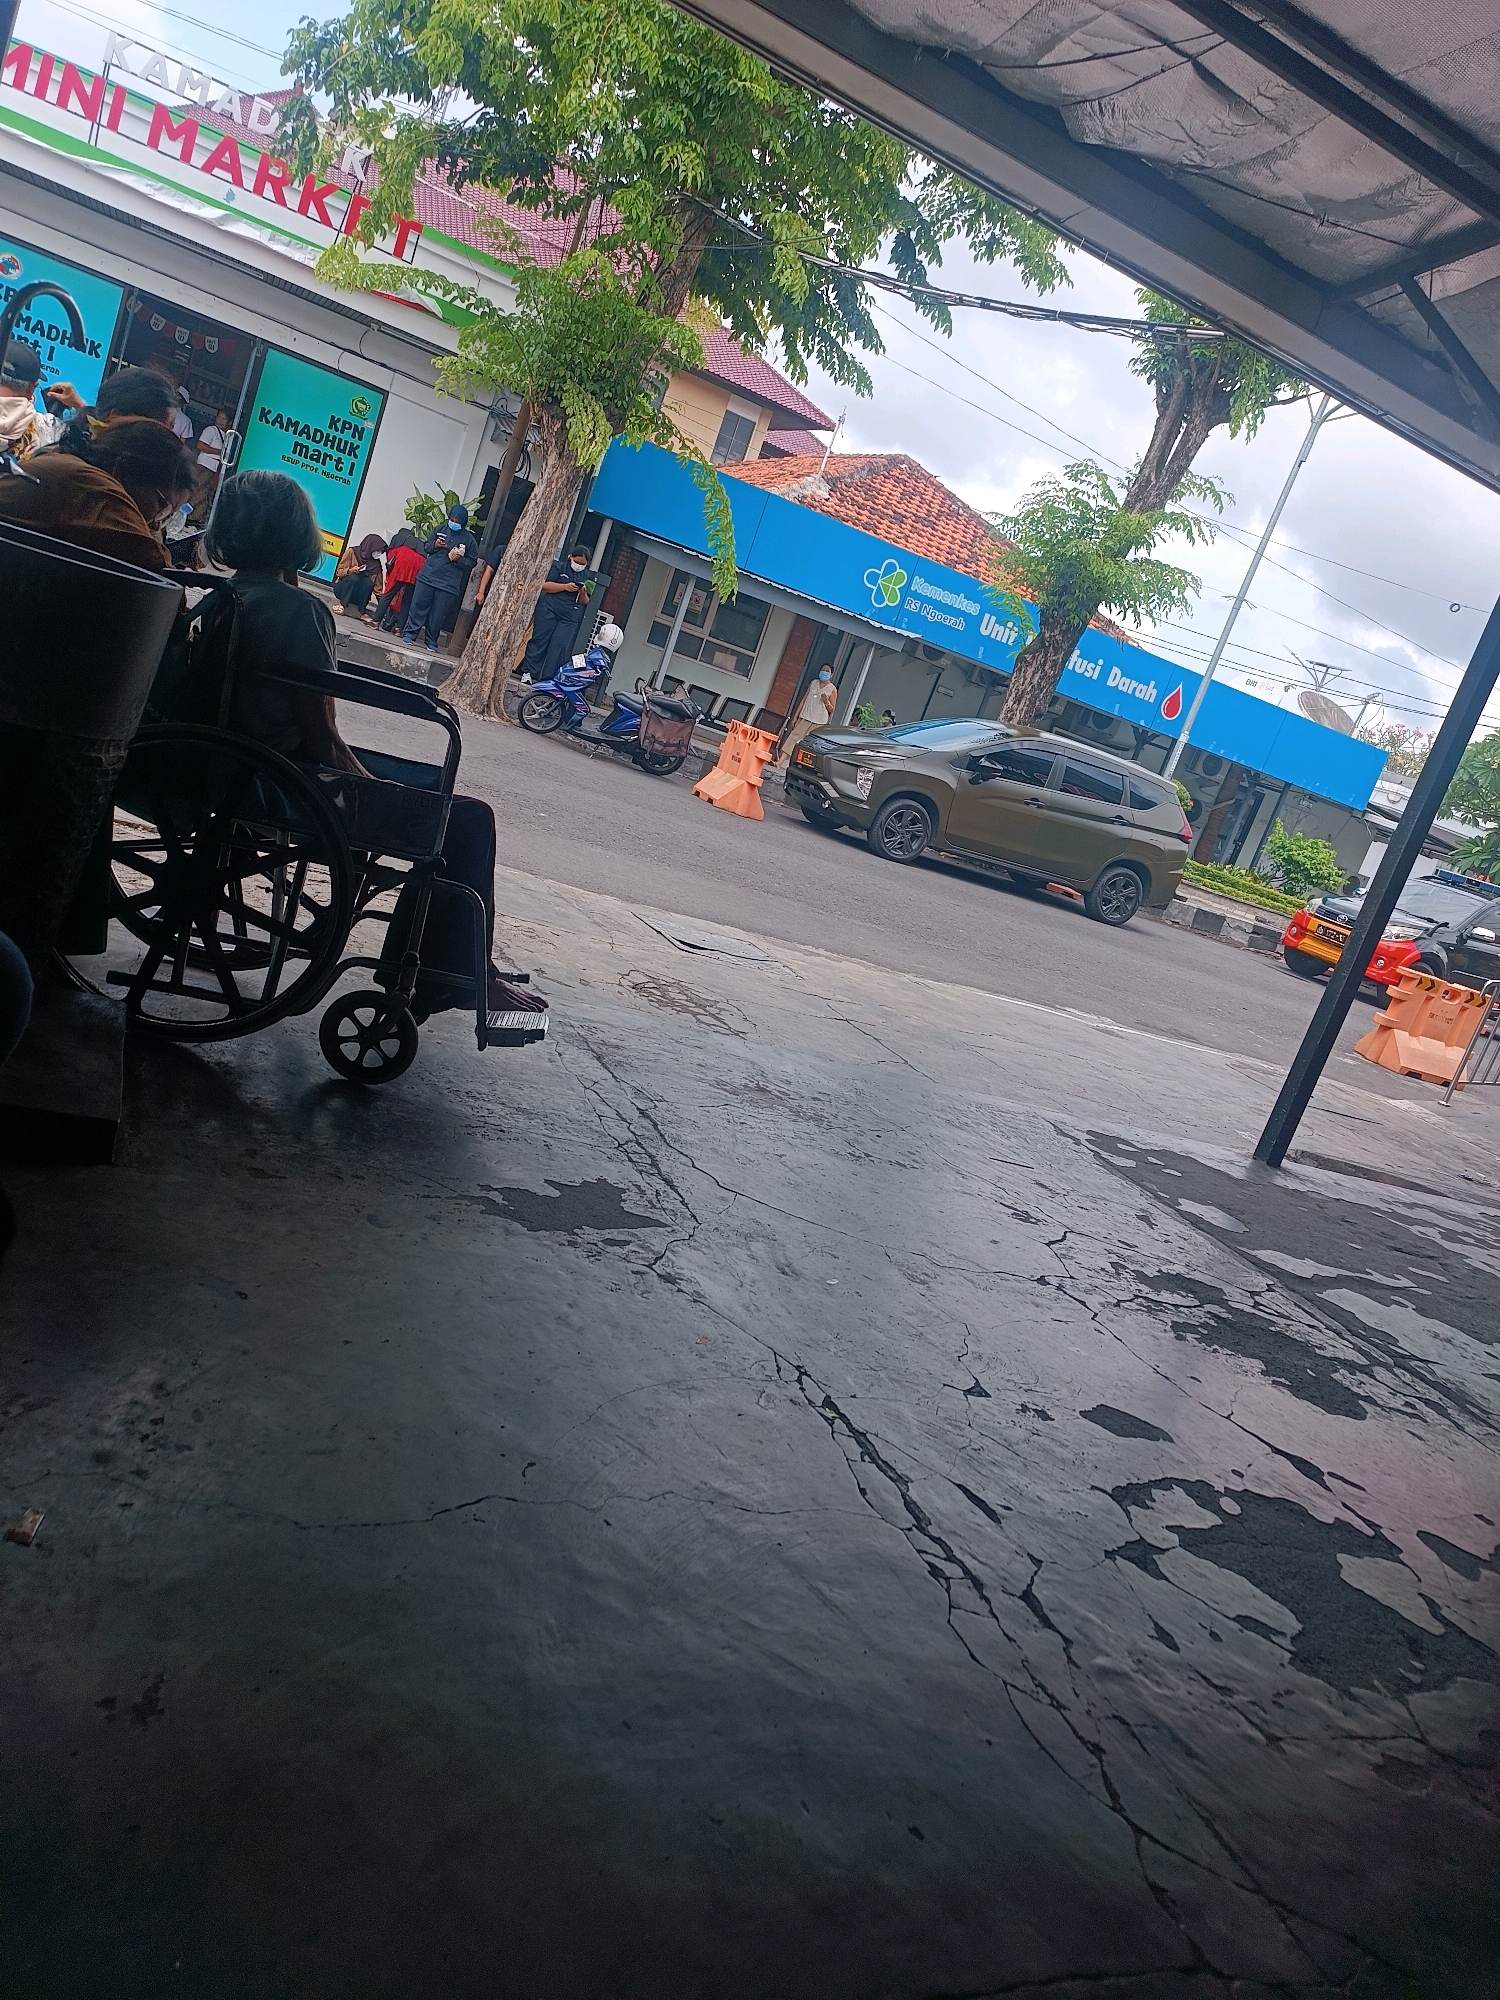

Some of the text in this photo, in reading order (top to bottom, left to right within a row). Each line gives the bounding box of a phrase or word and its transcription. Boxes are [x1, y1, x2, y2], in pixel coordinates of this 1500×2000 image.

[103, 31, 373, 182] KAMADK
[3, 43, 424, 259] MINI MARKET
[258, 406, 361, 460] KAMADHUK
[328, 414, 366, 442] KPN
[281, 454, 301, 466] RSUP
[291, 440, 345, 473] mart
[904, 597, 966, 632] RS Ngoerah
[910, 575, 981, 616] Kemenkes
[979, 612, 1019, 647] Unit
[1106, 665, 1159, 704] Darah
